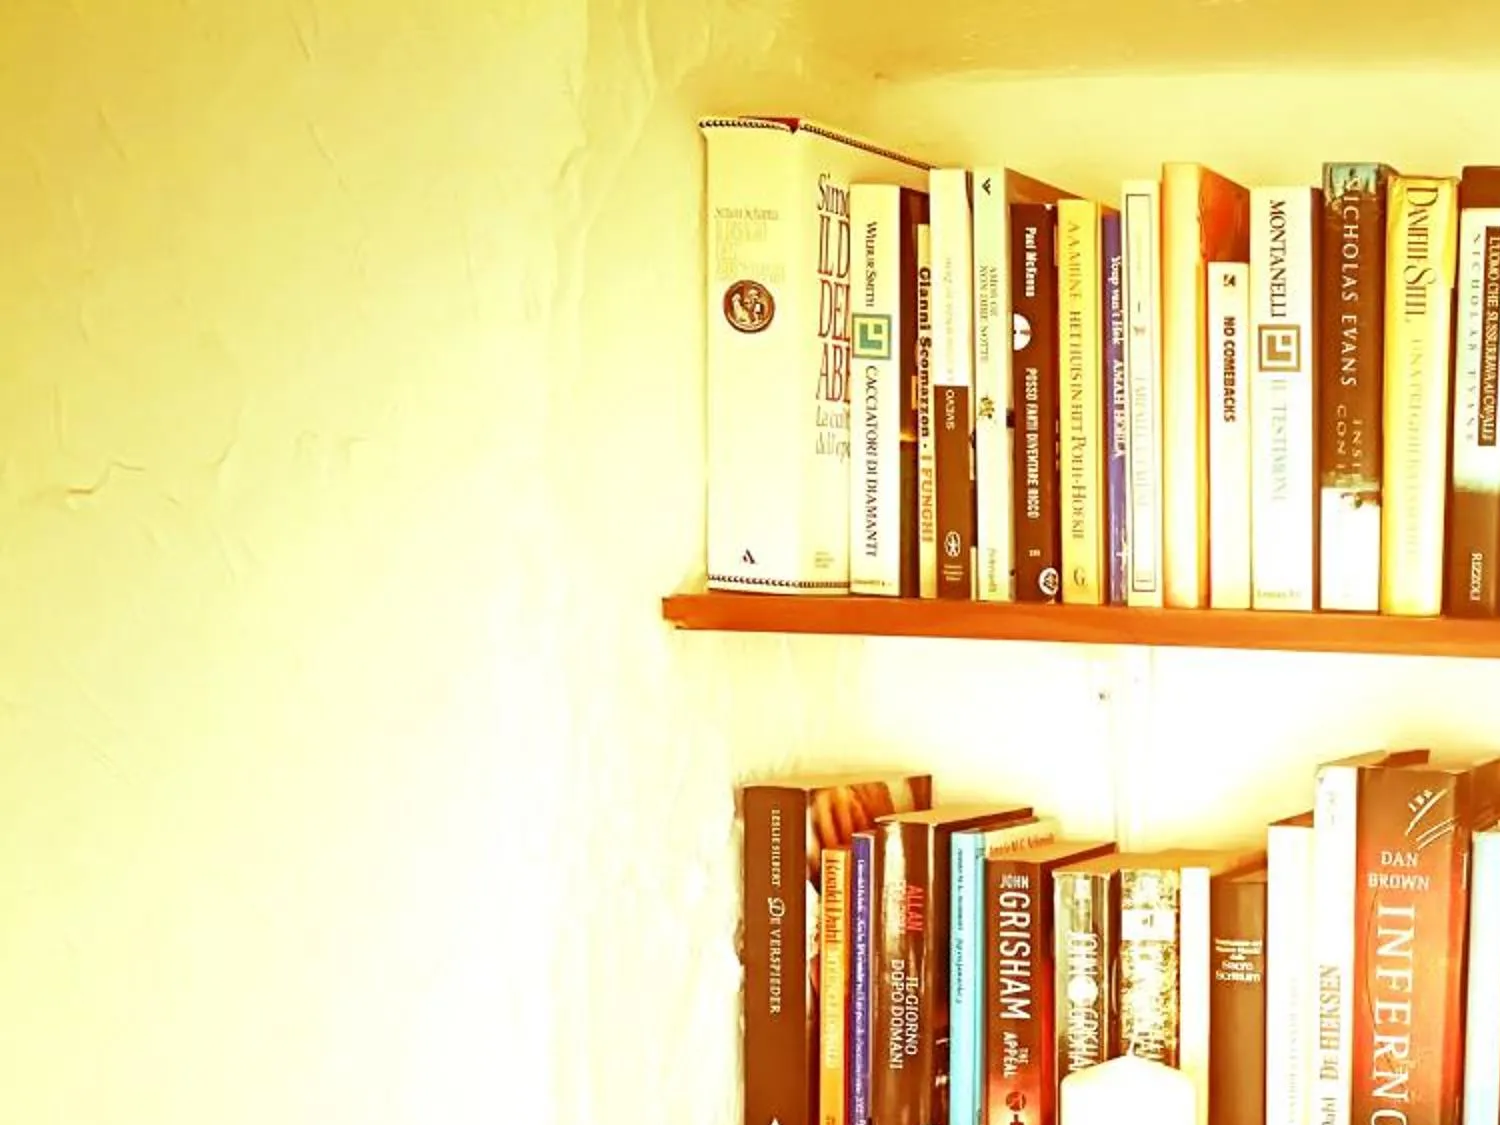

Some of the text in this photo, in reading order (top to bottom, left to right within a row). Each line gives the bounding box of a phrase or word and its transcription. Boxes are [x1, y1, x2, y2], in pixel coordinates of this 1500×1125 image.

[1023, 227, 1037, 298] Paul McKenna
[1268, 198, 1286, 319] MONTANELLI
[1340, 175, 1362, 387] NICHOLAS EVANS
[1486, 283, 1500, 308] CHE
[918, 266, 933, 543] Gianni Scomazzon FUNGHI
[1222, 315, 1236, 423] NO COMEBACKS
[863, 365, 879, 461] CACCIATORI
[1024, 367, 1038, 519] POSSO FARTI DIVENTARE RICCO
[863, 478, 879, 558] DIAMANTI
[1469, 552, 1483, 602] RIZZOLI
[905, 884, 924, 931] ALLAN
[1367, 850, 1431, 891] DAN BROWN
[768, 929, 782, 1014] VERSPIEDER
[998, 890, 1031, 1019] GRISHAM
[889, 958, 905, 1070] DOPO DOMANI
[904, 995, 919, 1055] GIORNO
[1066, 931, 1099, 1076] JOHN GRISHA
[1318, 964, 1341, 1051] HEKSEN
[1001, 1031, 1019, 1079] APPEAL
